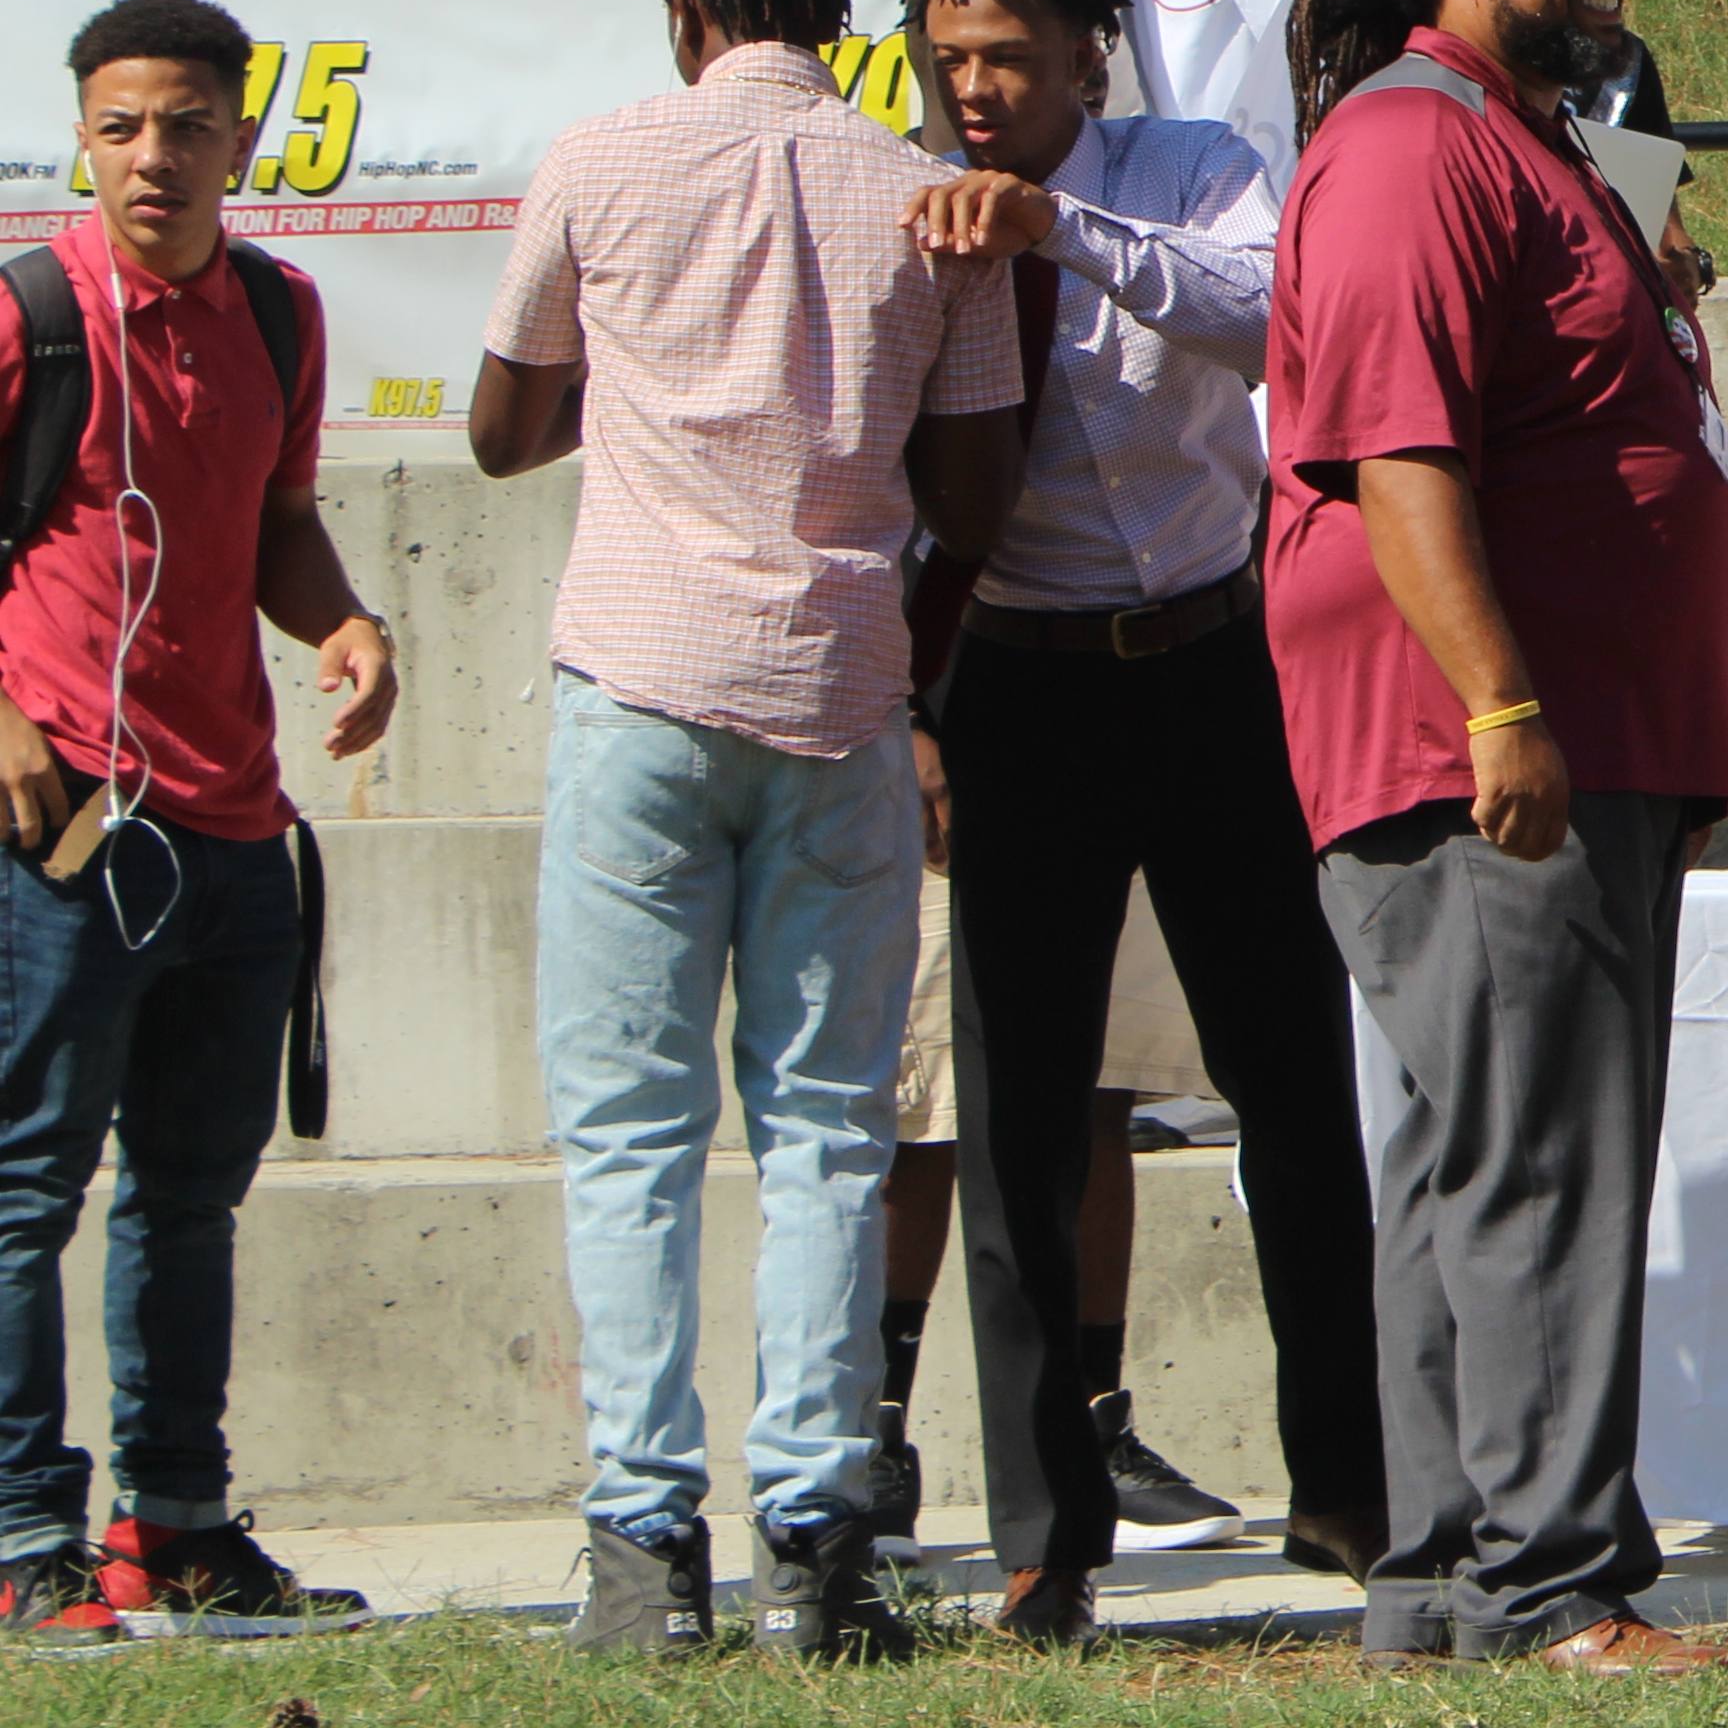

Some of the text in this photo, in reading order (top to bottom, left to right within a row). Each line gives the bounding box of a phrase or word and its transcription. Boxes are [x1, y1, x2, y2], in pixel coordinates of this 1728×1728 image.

[358, 159, 478, 179] HipHopNC.com
[225, 208, 279, 236] TION
[280, 206, 327, 234] FOR
[331, 205, 369, 232] HIP
[374, 203, 424, 230] HOP
[426, 201, 481, 229] AND
[369, 377, 445, 418] K97.5
[766, 1609, 798, 1631] 23
